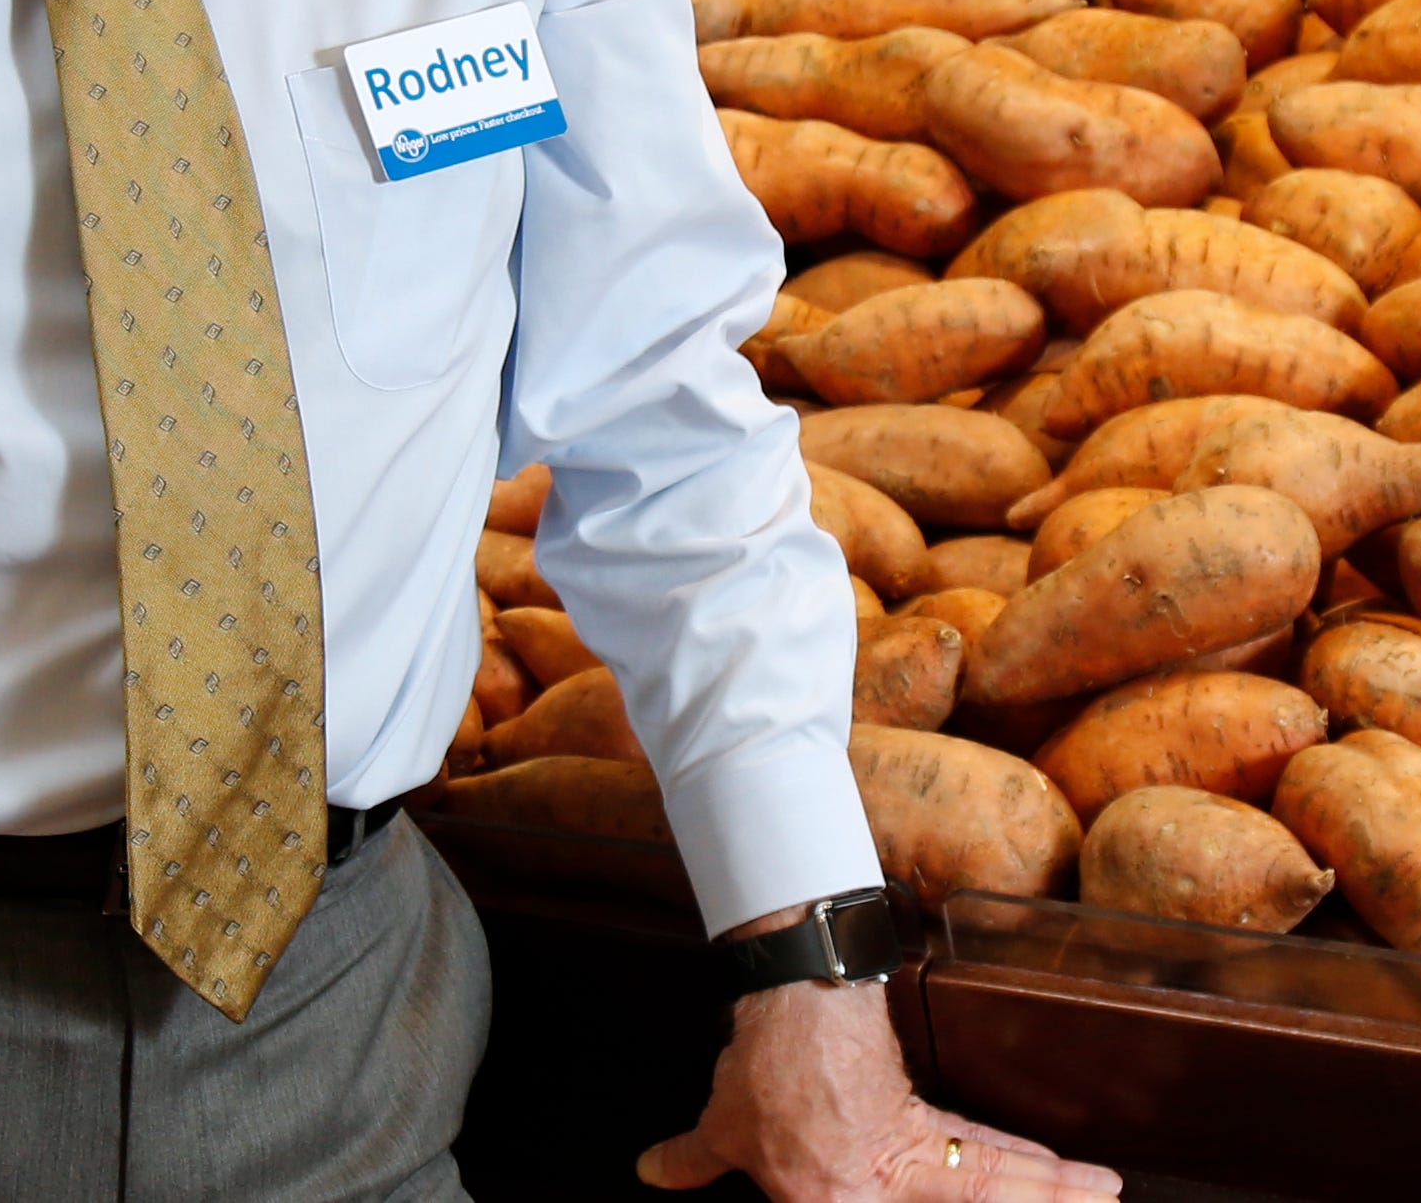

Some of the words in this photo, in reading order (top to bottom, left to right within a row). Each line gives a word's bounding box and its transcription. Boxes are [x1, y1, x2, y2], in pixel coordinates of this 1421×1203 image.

[363, 38, 530, 110] Rodney
[430, 132, 449, 144] Low
[450, 125, 479, 142] prices.
[478, 117, 505, 130] Faster
[505, 105, 546, 122] checkout.
[394, 134, 425, 157] Kroger
